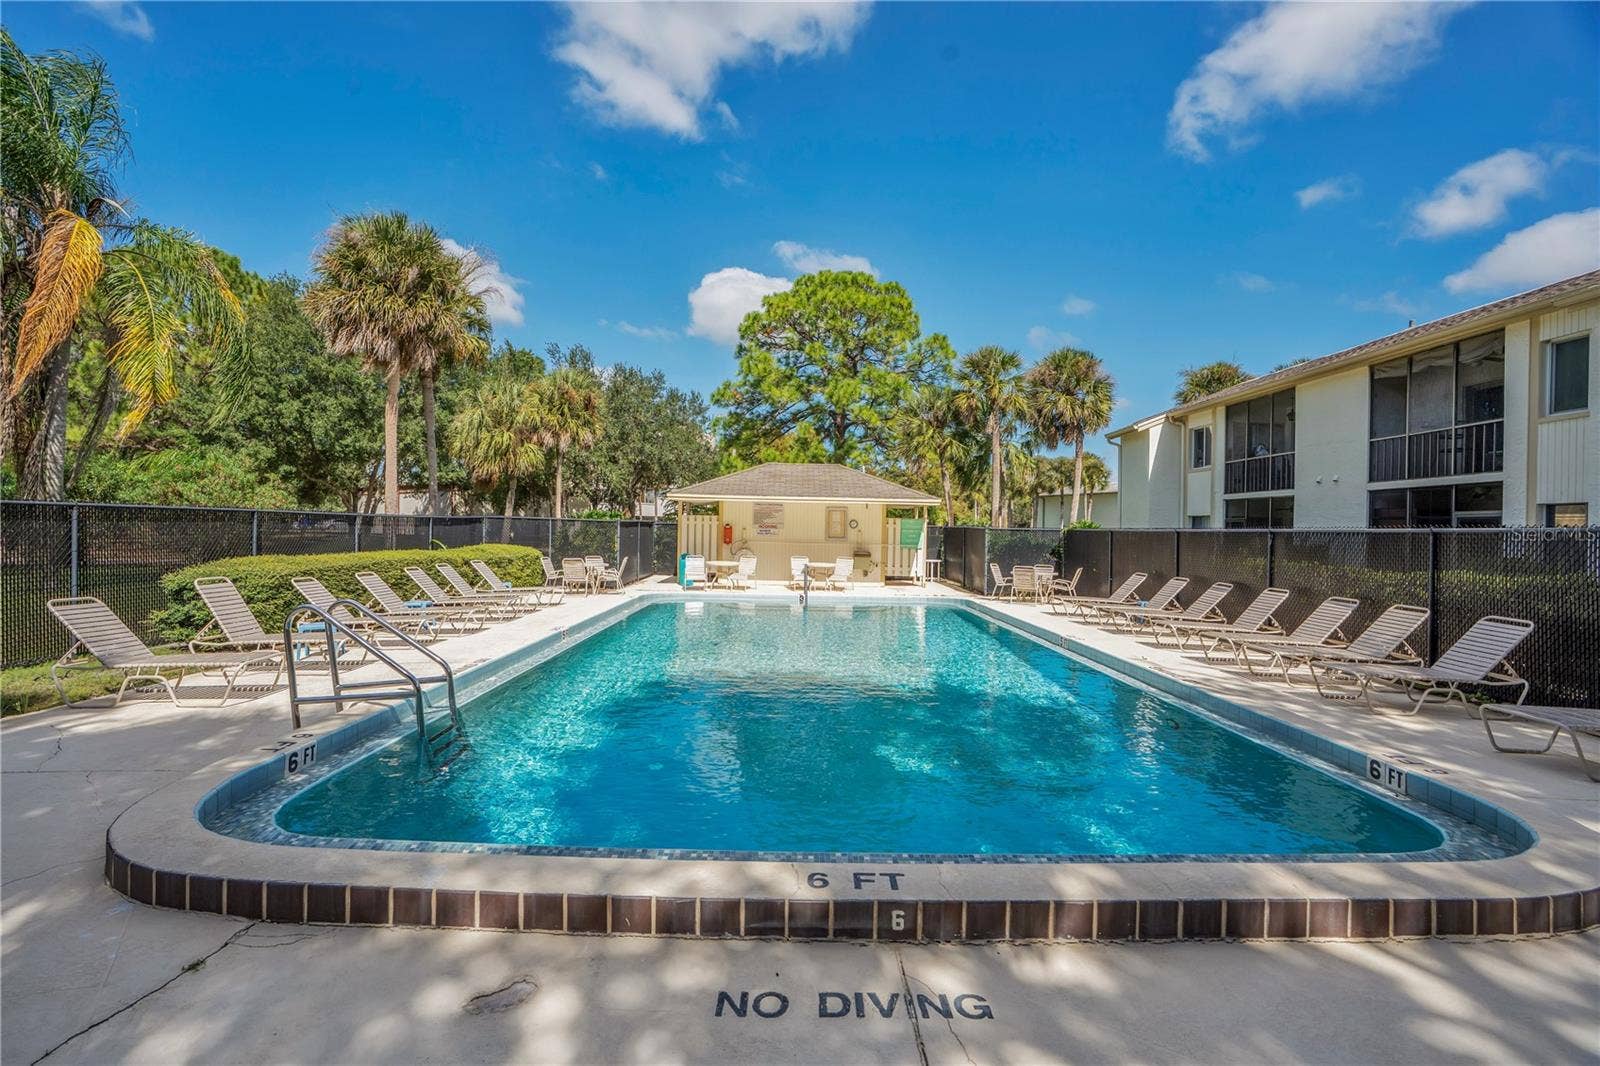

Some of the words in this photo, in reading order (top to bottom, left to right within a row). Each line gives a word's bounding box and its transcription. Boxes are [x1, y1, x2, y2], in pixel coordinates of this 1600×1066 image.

[288, 752, 298, 772] 6
[303, 744, 315, 765] FT
[1369, 758, 1381, 780] 6
[1388, 768, 1403, 788] FT
[807, 872, 829, 889] 6
[853, 872, 905, 890] FT
[890, 909, 906, 931] 6
[714, 990, 789, 1018] NO
[818, 991, 995, 1020] DIVING
